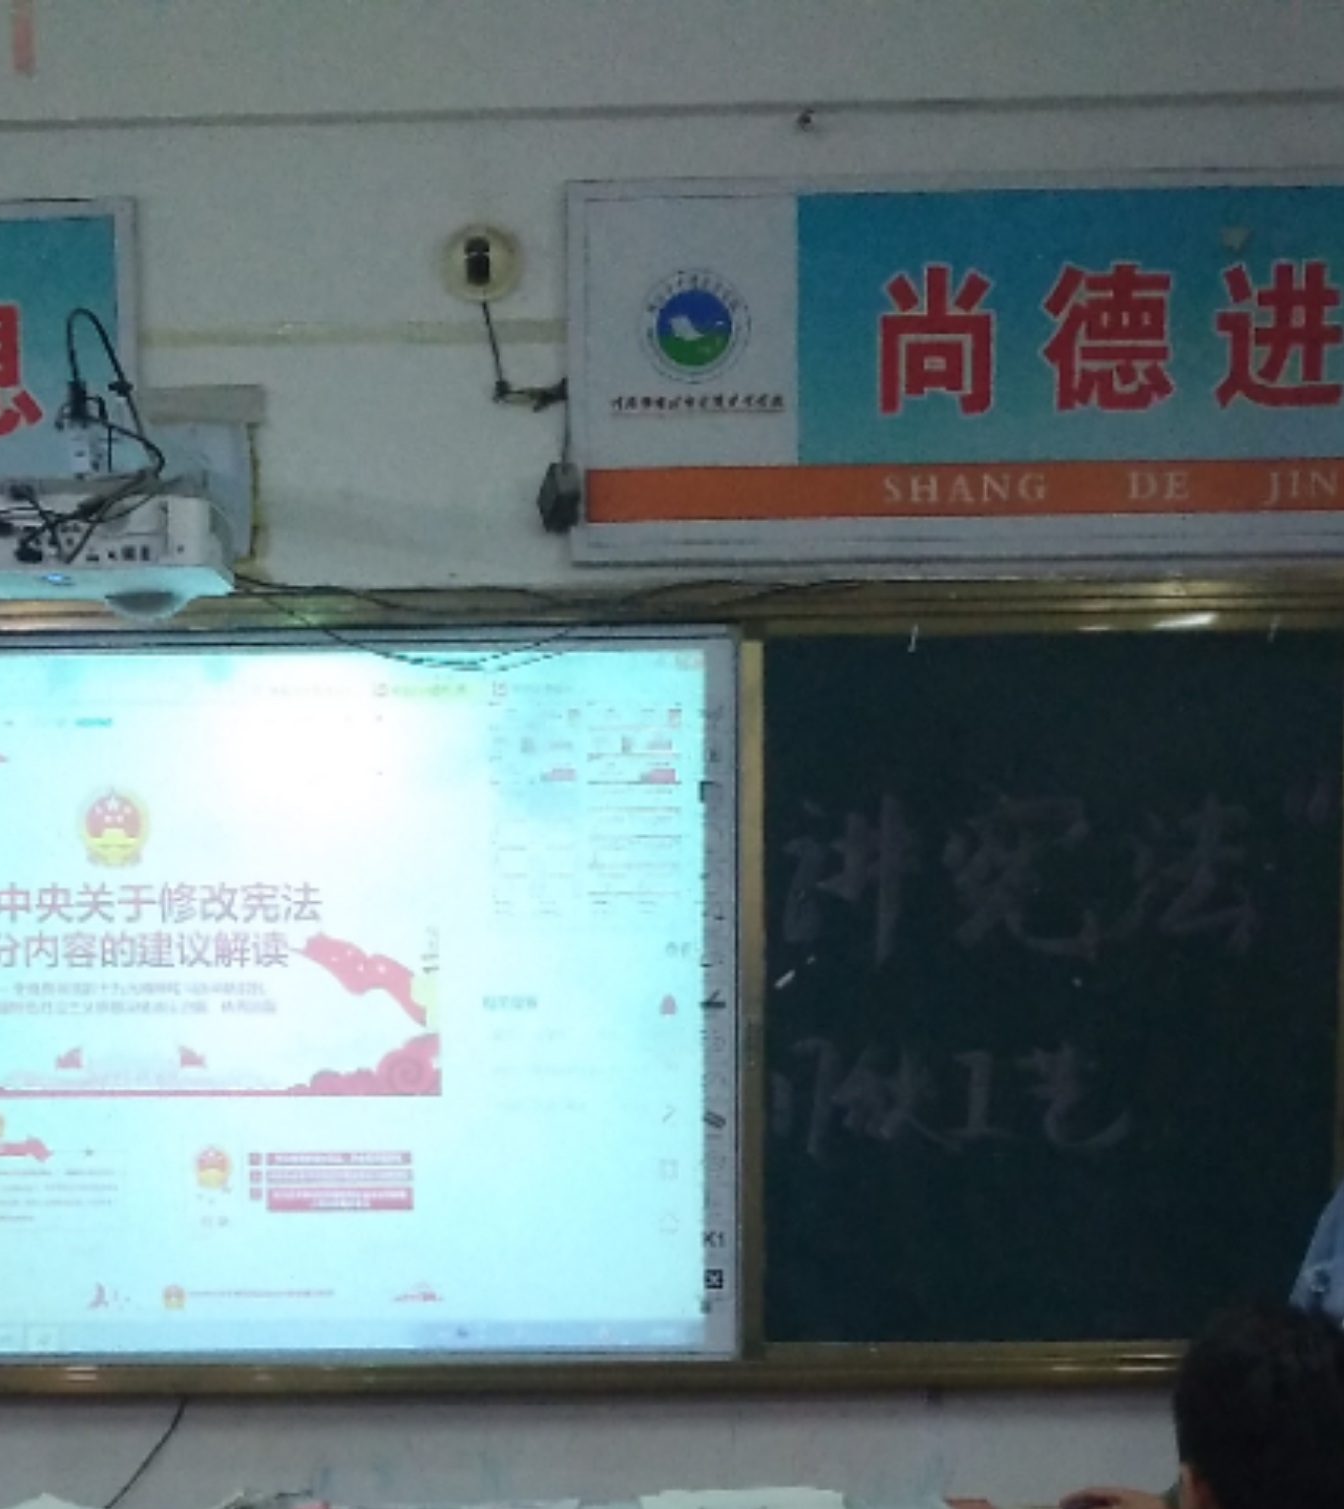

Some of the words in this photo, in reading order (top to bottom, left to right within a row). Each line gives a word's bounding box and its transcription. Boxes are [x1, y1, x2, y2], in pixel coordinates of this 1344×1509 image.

[883, 473, 1046, 503] SHANG
[1128, 470, 1191, 500] DE
[1267, 468, 1340, 502] JIN
